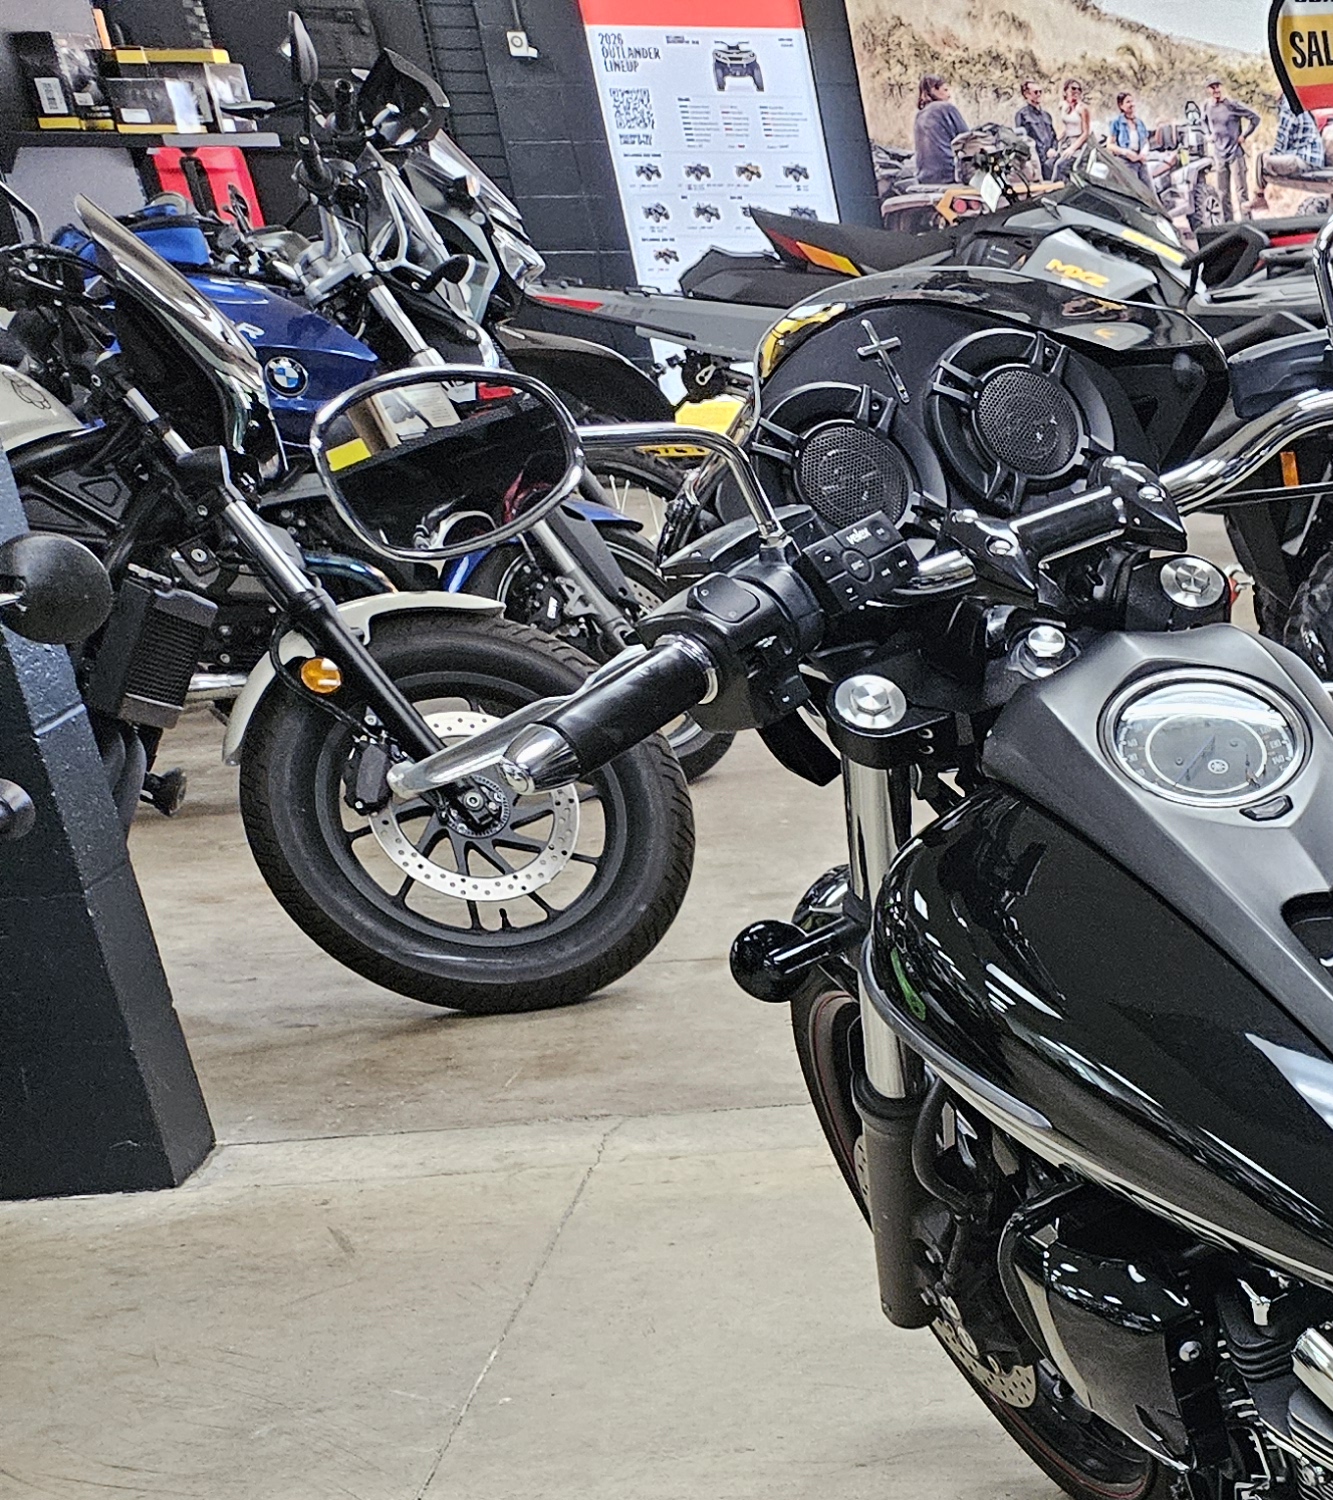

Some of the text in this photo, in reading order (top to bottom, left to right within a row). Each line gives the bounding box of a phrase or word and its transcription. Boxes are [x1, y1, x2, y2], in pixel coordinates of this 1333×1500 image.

[598, 33, 624, 46] 2026
[601, 46, 661, 60] OUTLANDER
[604, 60, 640, 73] LINEUP
